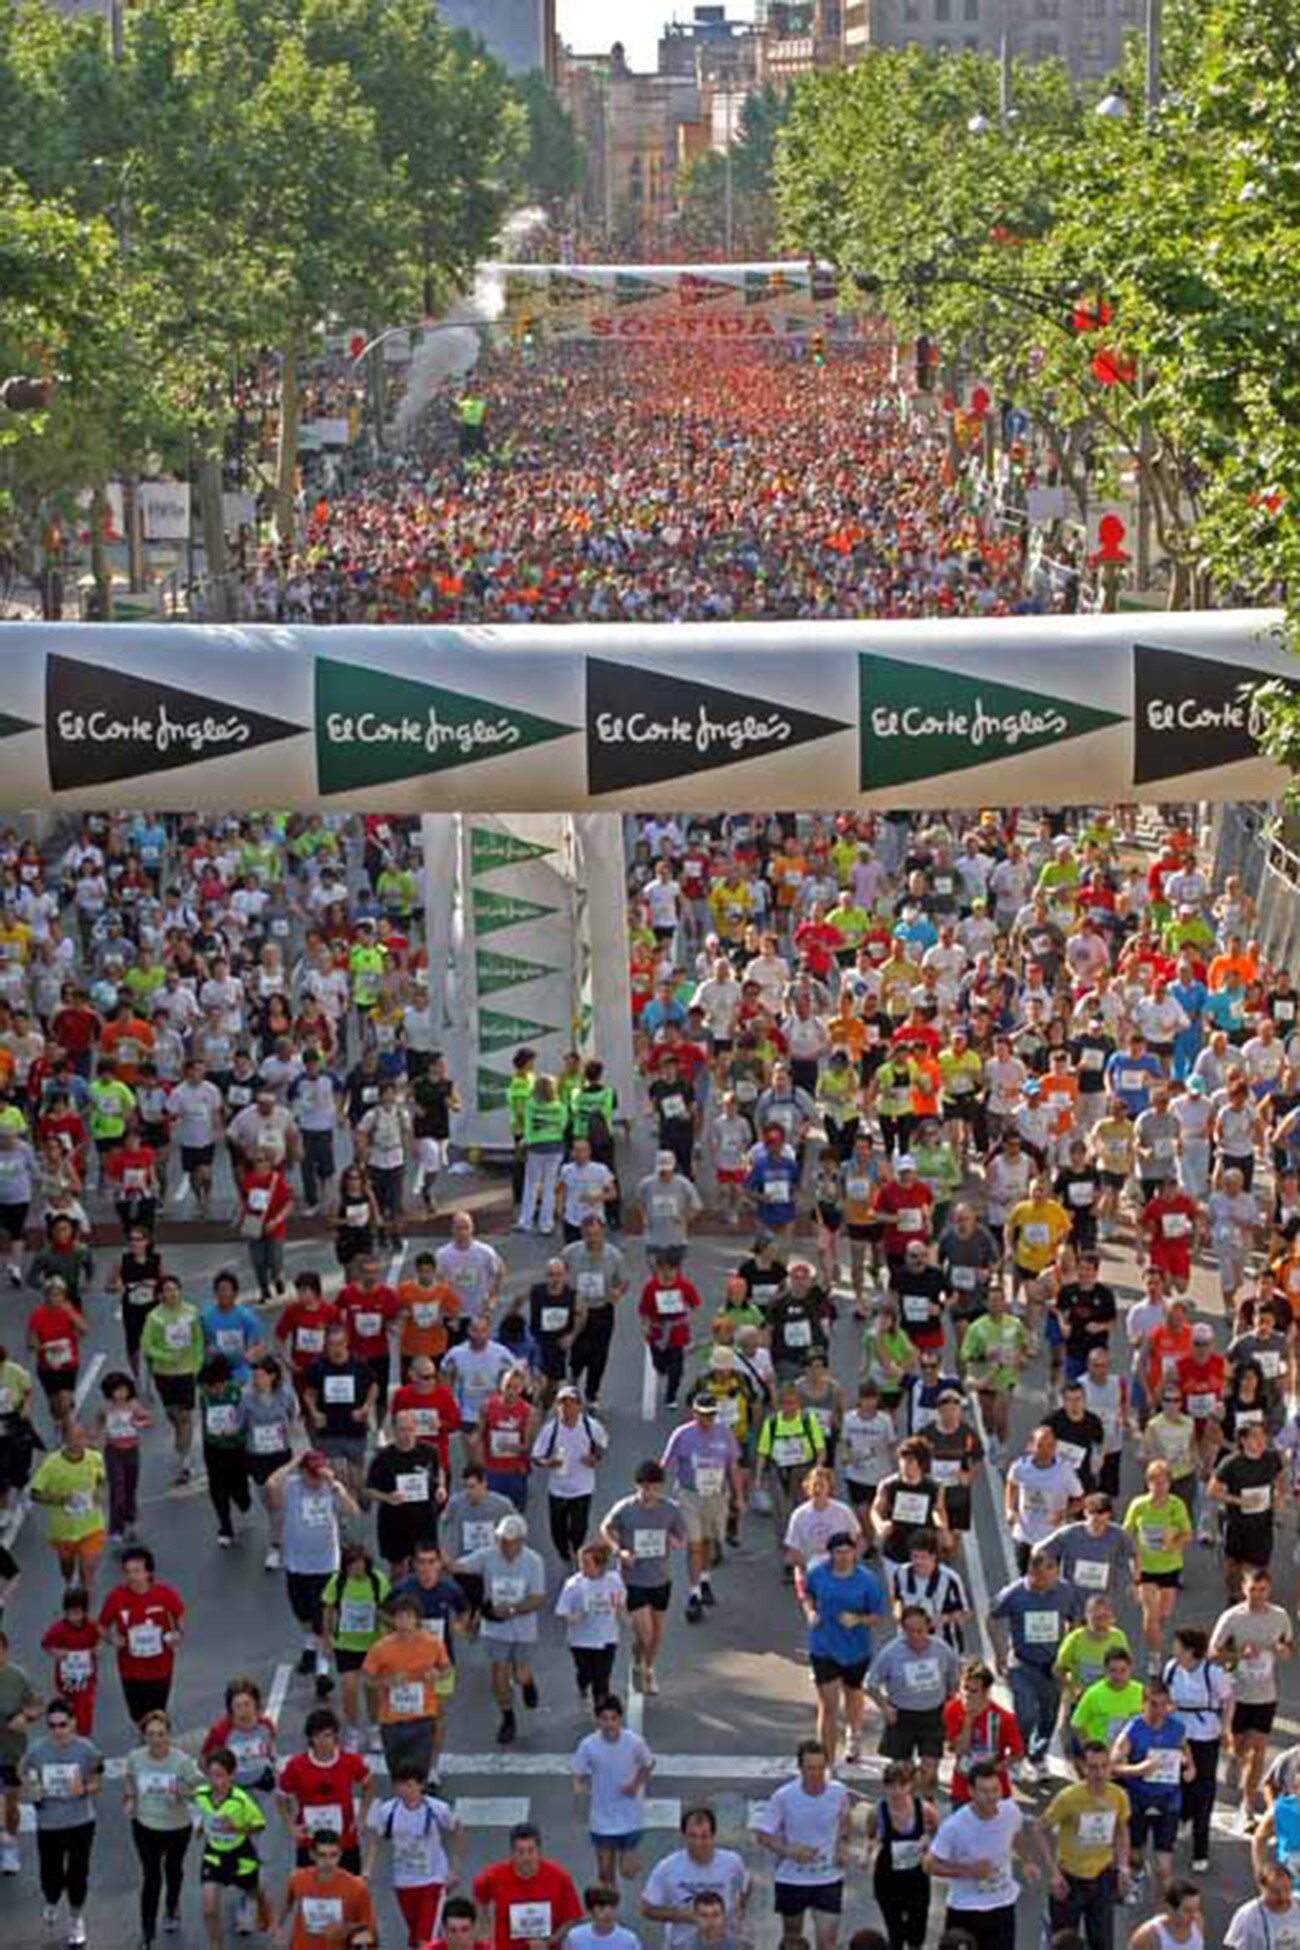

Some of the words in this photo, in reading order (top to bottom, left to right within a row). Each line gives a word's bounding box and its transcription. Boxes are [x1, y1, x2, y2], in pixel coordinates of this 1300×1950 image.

[58, 710, 85, 740] El
[88, 711, 153, 741] Corte
[327, 713, 355, 742] El
[357, 713, 423, 742] Corte
[596, 713, 624, 742] El
[627, 713, 692, 742] Corte
[872, 707, 899, 737] El
[902, 707, 968, 737] Corte
[1147, 700, 1174, 729] El
[1178, 699, 1243, 729] Corte
